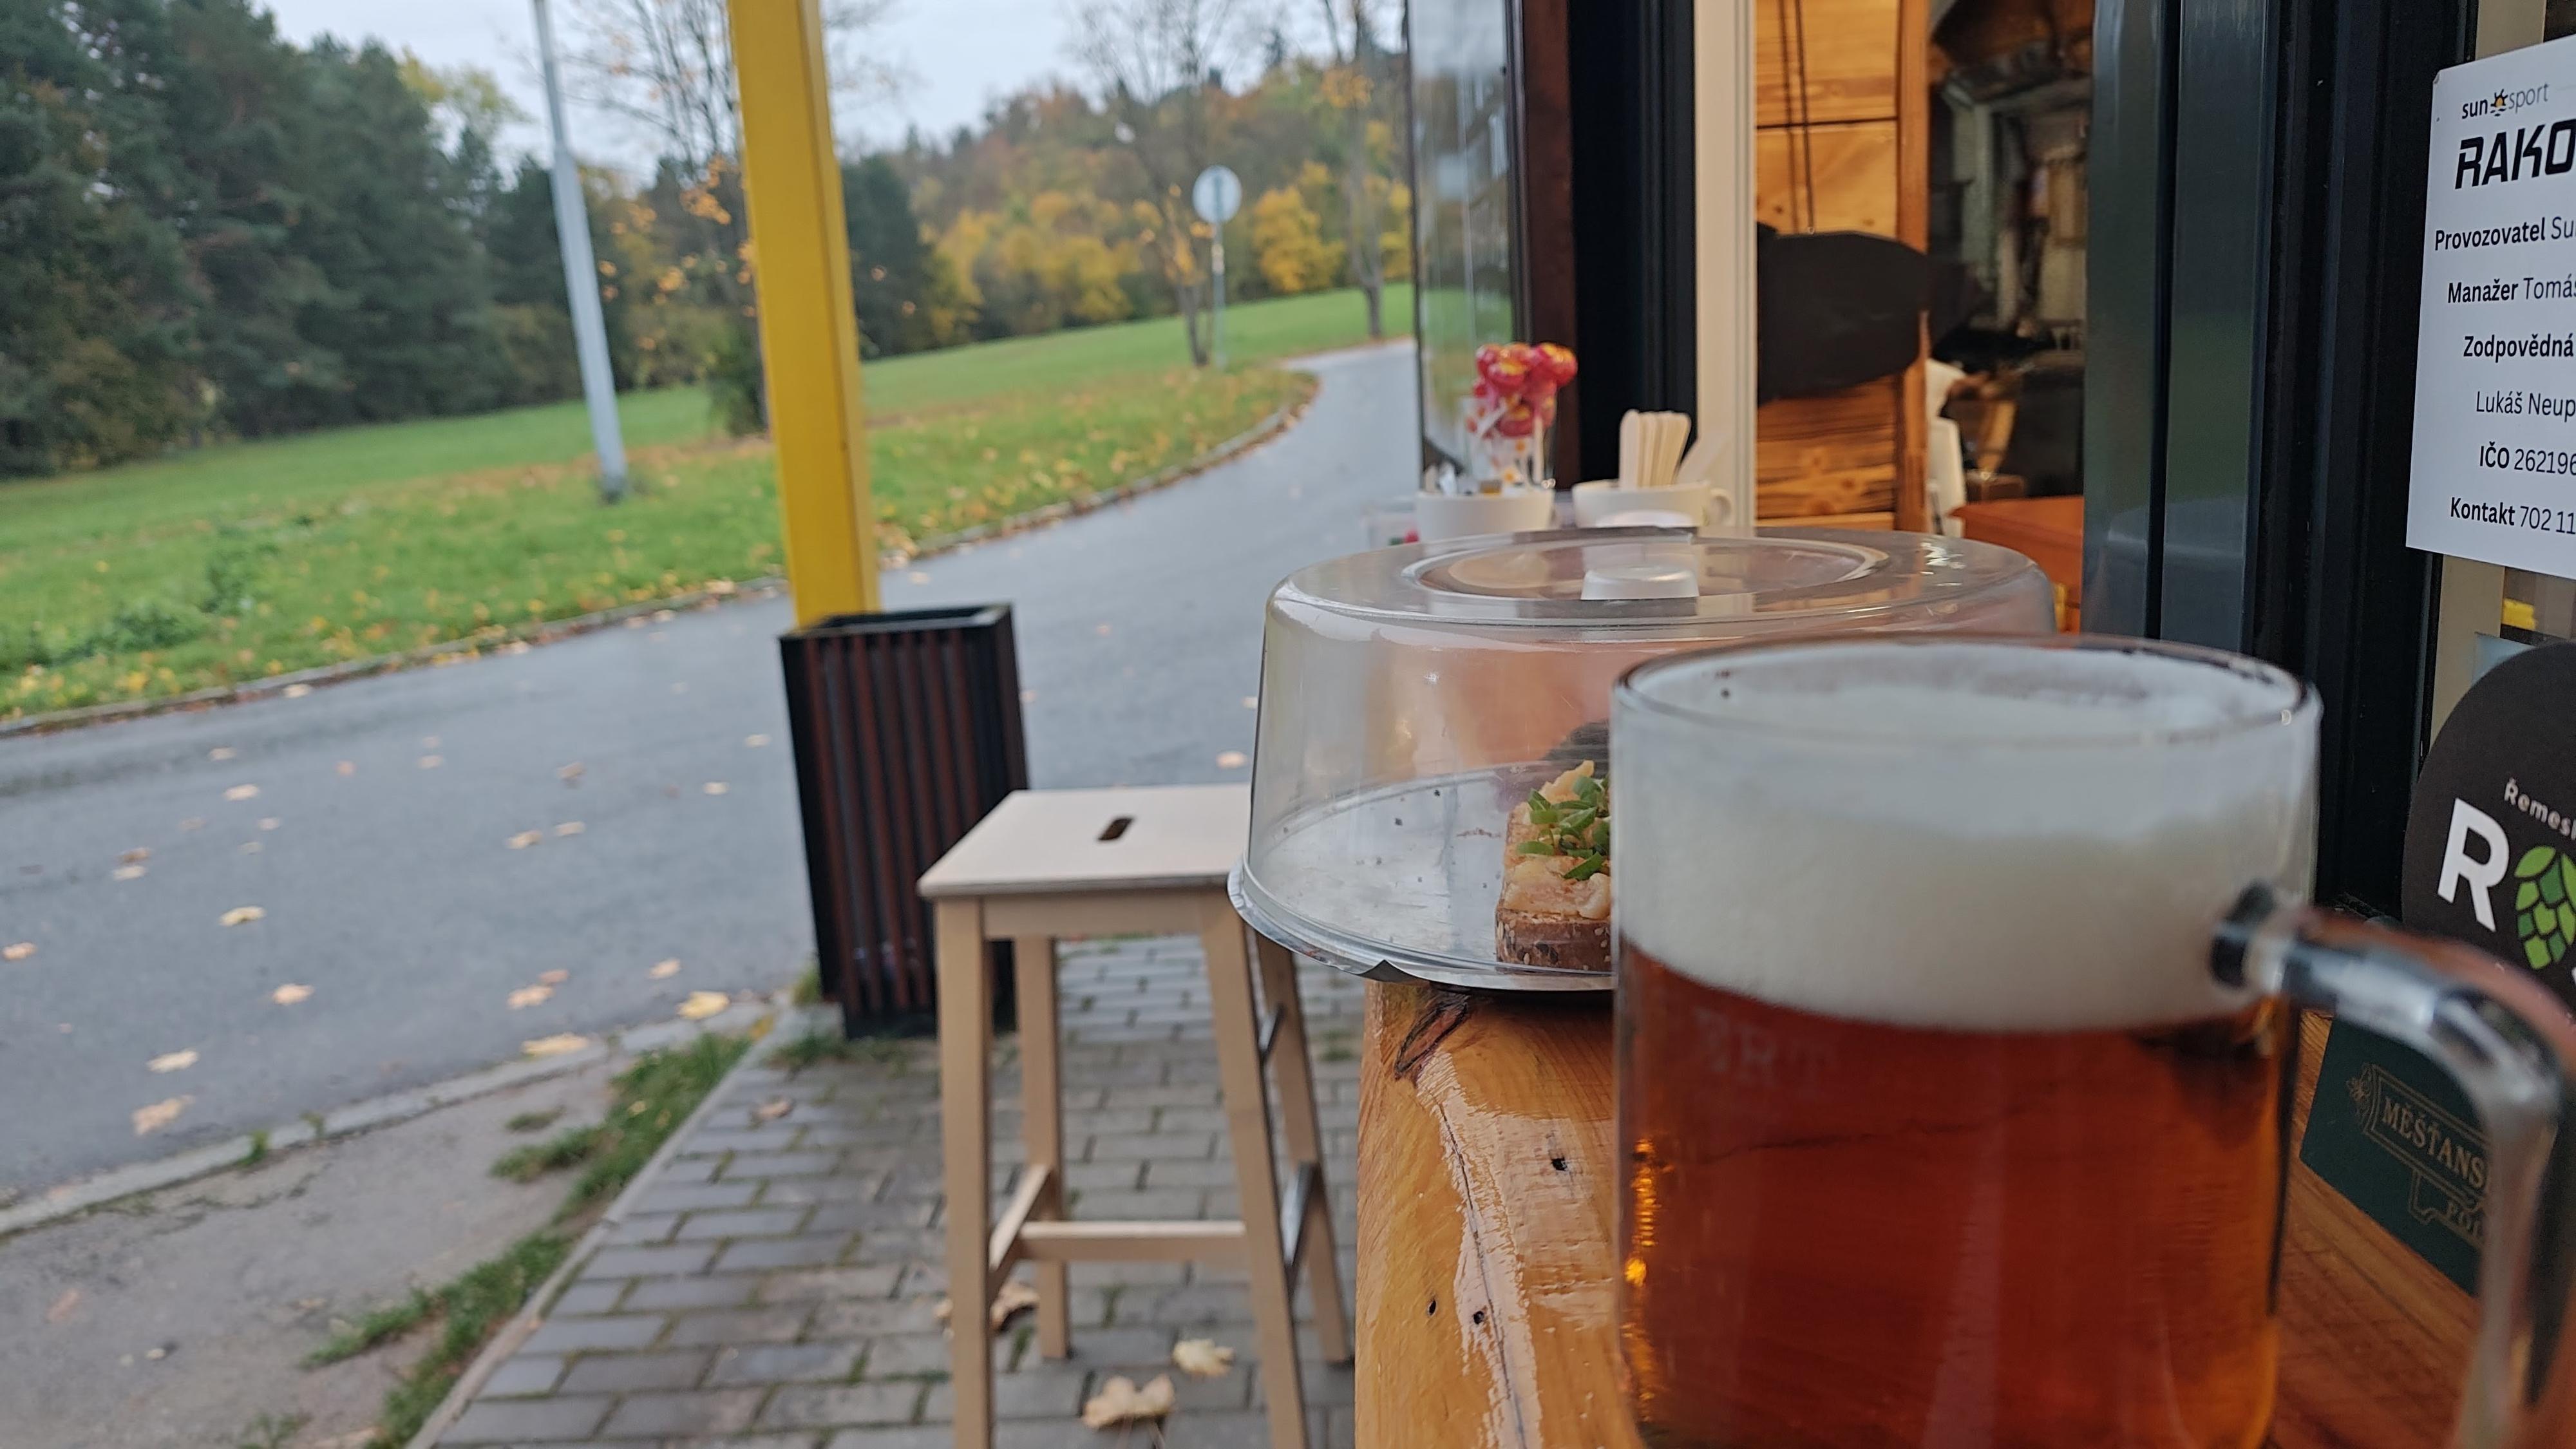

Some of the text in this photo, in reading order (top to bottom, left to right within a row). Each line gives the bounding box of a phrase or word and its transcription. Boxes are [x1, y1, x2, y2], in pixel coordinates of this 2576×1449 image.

[2461, 83, 2549, 119] sun sport
[2435, 216, 2545, 251] Provozovatel
[2447, 278, 2519, 303] Manažer
[2463, 332, 2574, 363] Zodpovědná
[2476, 390, 2576, 422] Lukáš Neup
[2479, 441, 2510, 469] IČO
[2450, 497, 2576, 535] Kontakt 702 11
